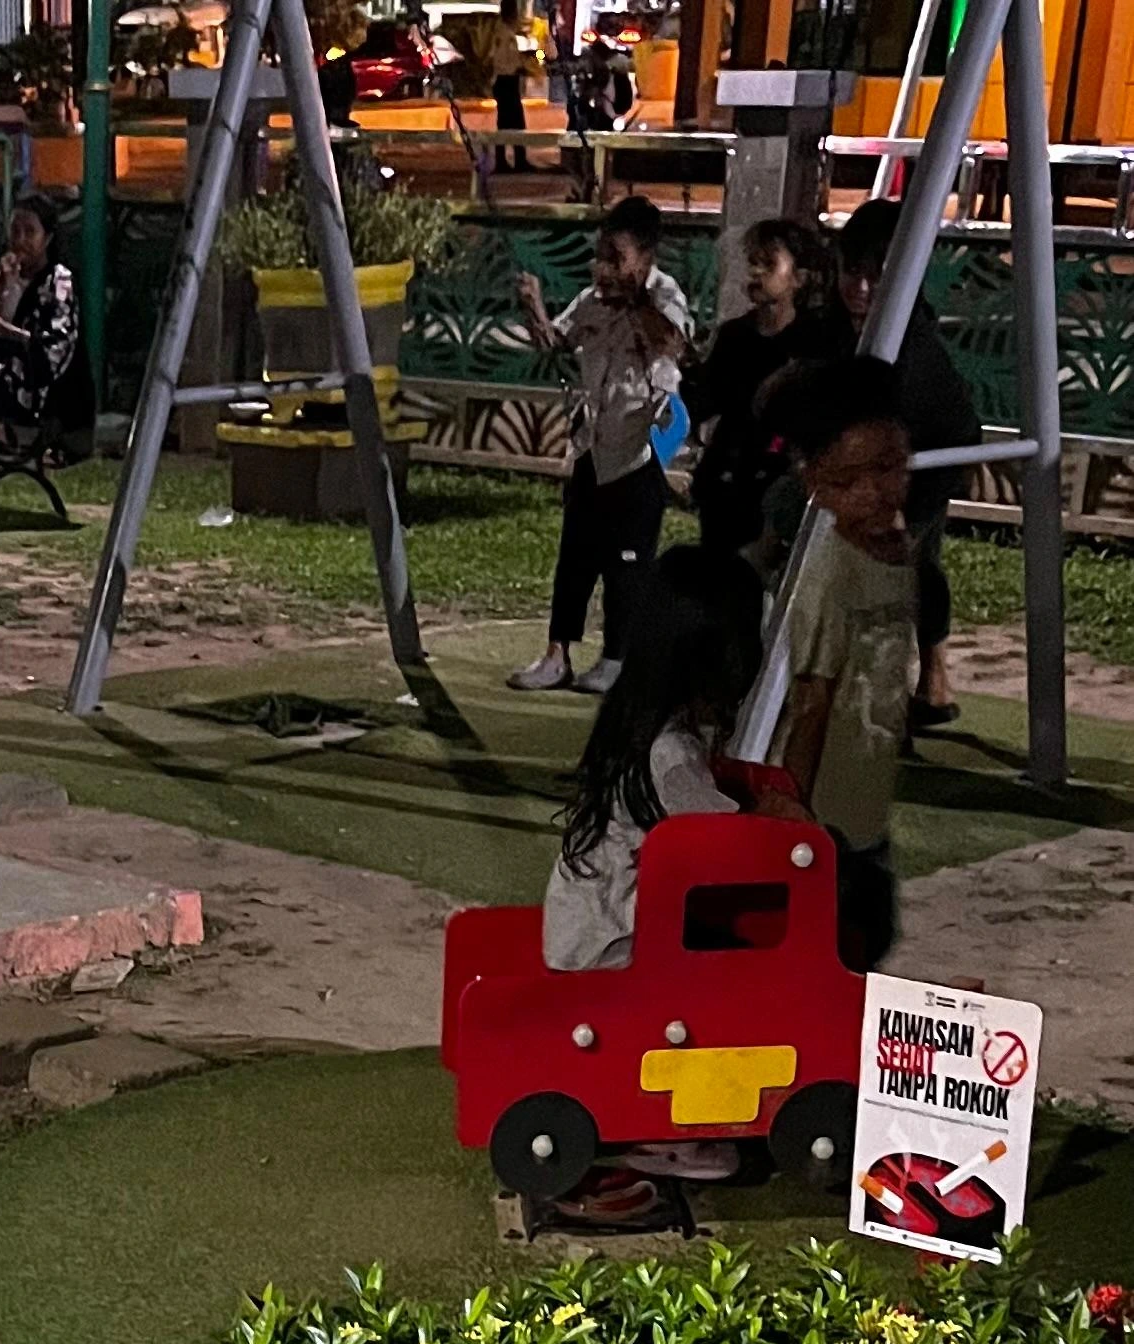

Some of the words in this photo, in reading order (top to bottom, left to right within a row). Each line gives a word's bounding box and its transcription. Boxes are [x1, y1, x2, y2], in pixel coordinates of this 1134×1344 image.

[876, 1036, 937, 1077] SEHAT
[878, 1007, 976, 1058] KAWASAN
[878, 1067, 938, 1107] TANPA
[943, 1076, 1011, 1121] ROKOK
